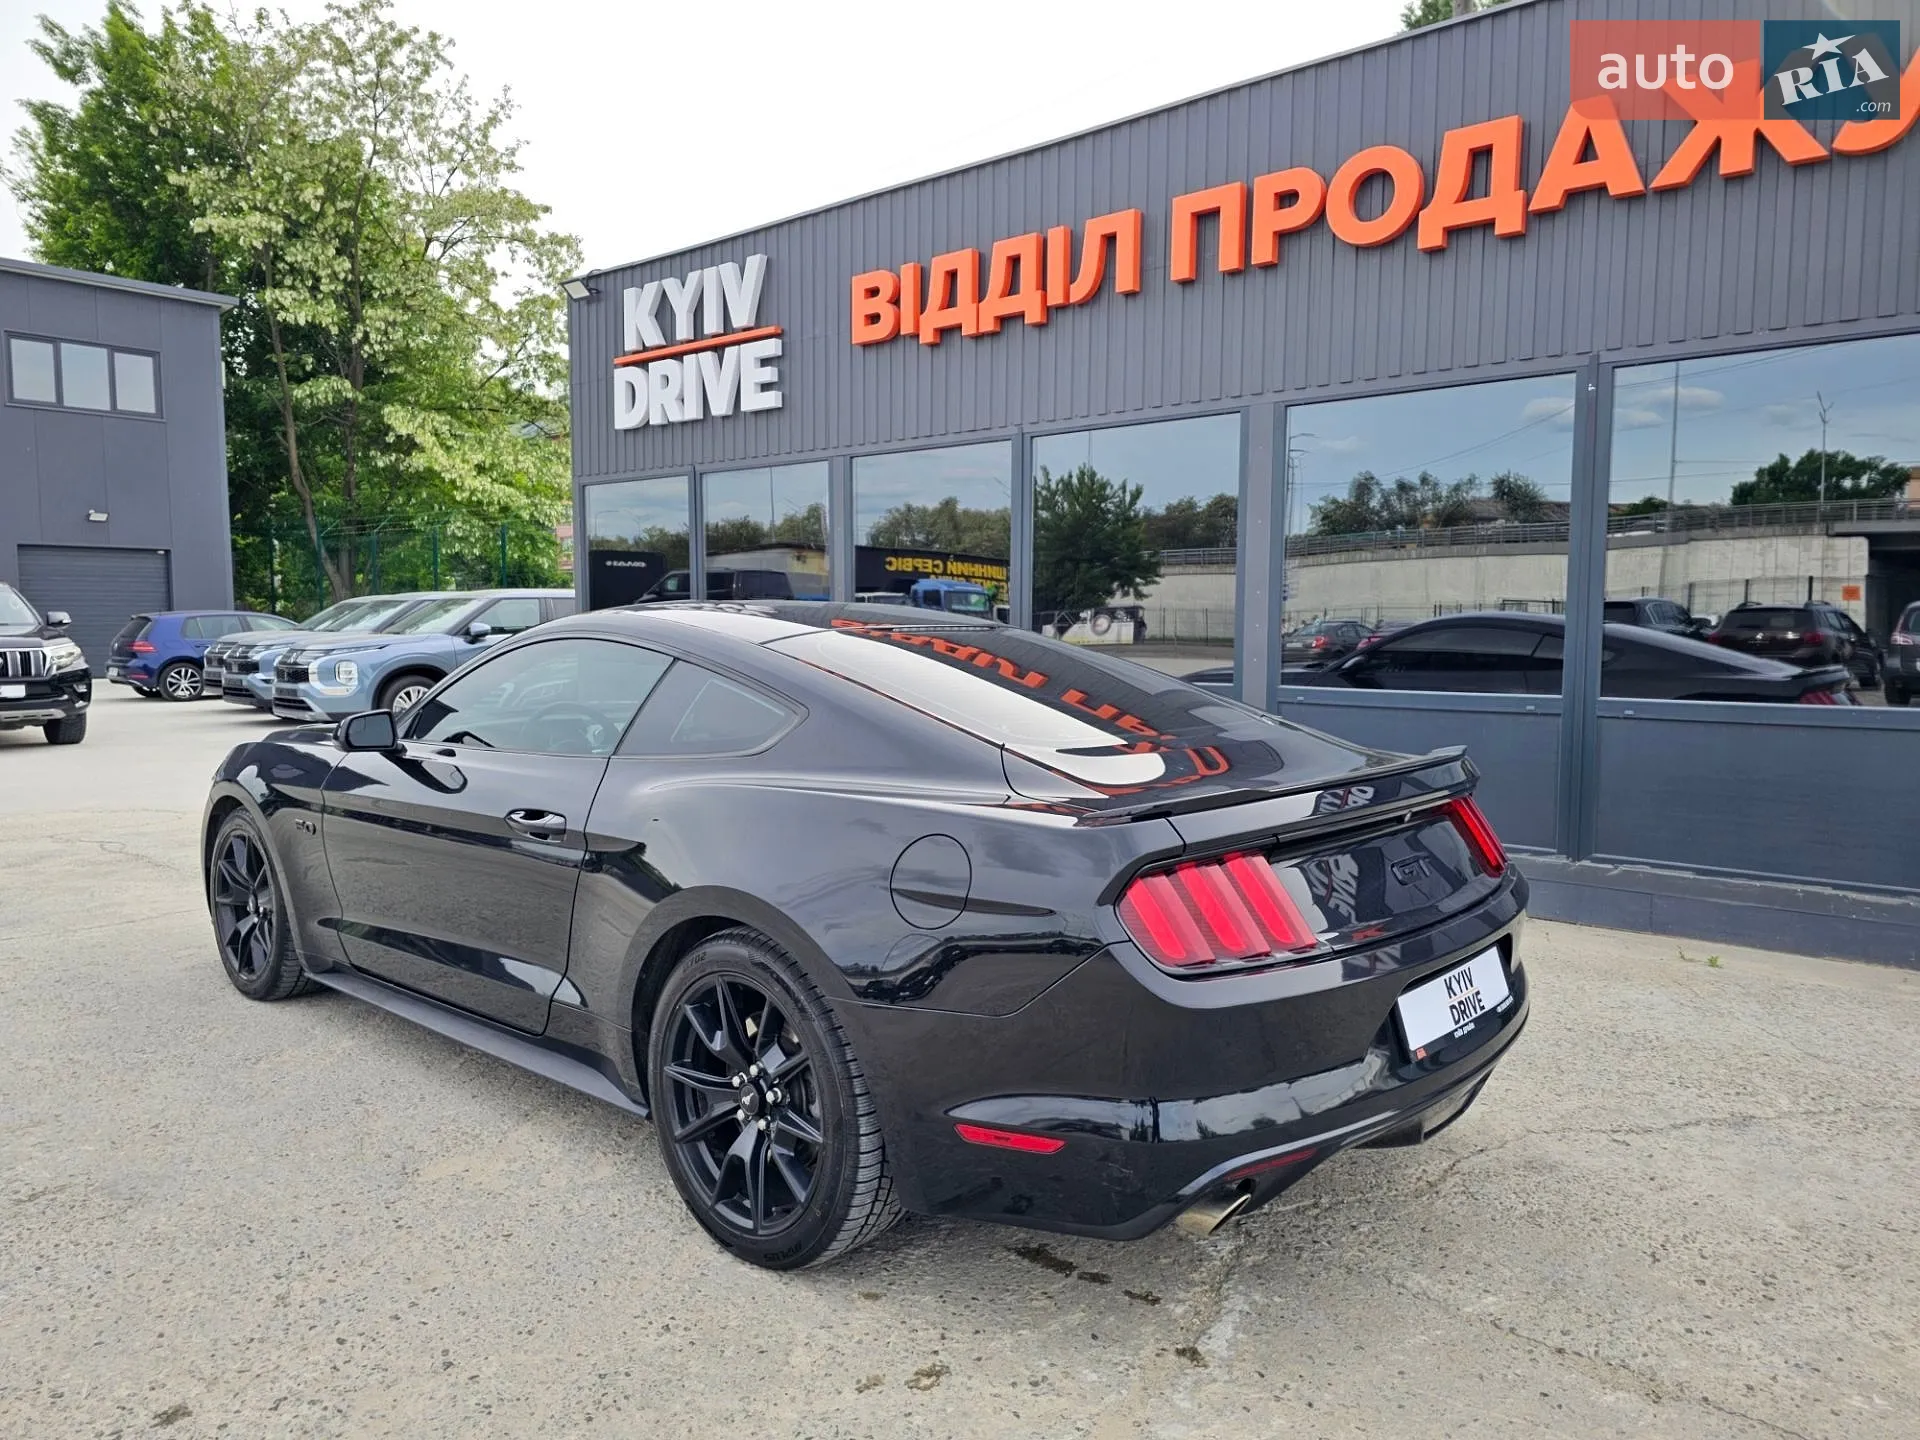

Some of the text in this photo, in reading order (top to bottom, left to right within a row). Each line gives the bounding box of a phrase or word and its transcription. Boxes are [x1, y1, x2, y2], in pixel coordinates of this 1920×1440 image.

[623, 253, 768, 353] KYIV
[851, 208, 1143, 347] ВІДДІЛ
[614, 338, 783, 430] DRIVE
[1444, 967, 1474, 999] KYIV
[1448, 990, 1486, 1026] DRIVE
